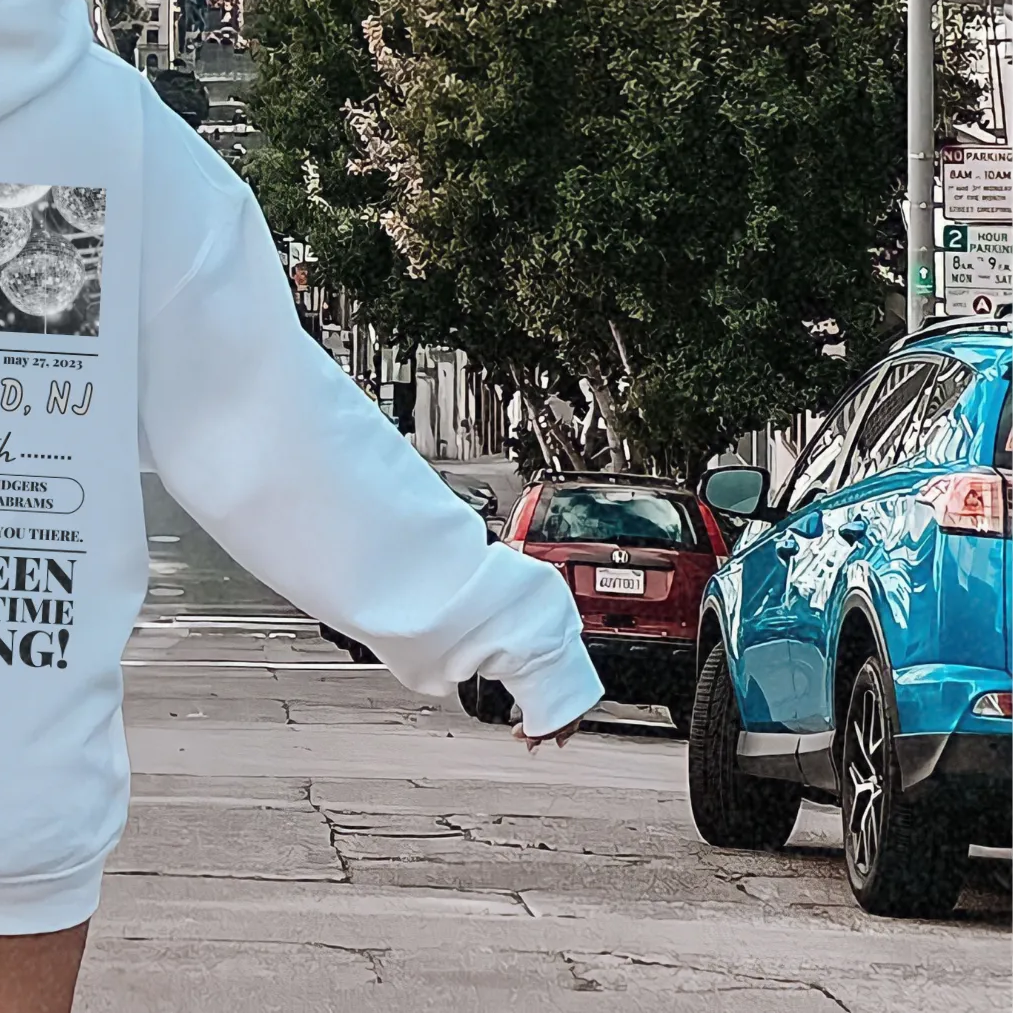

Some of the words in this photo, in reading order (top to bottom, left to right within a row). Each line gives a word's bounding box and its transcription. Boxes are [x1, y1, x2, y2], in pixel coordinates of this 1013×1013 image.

[944, 150, 963, 162] NO
[966, 152, 1012, 162] PARKING
[984, 170, 1012, 180] 10AM
[949, 229, 962, 248] 2
[978, 232, 1008, 242] HOUR
[951, 273, 973, 283] MON
[3, 356, 29, 368] may
[53, 359, 83, 370] 2023
[46, 379, 94, 416] NJ
[29, 528, 84, 543] THERE.
